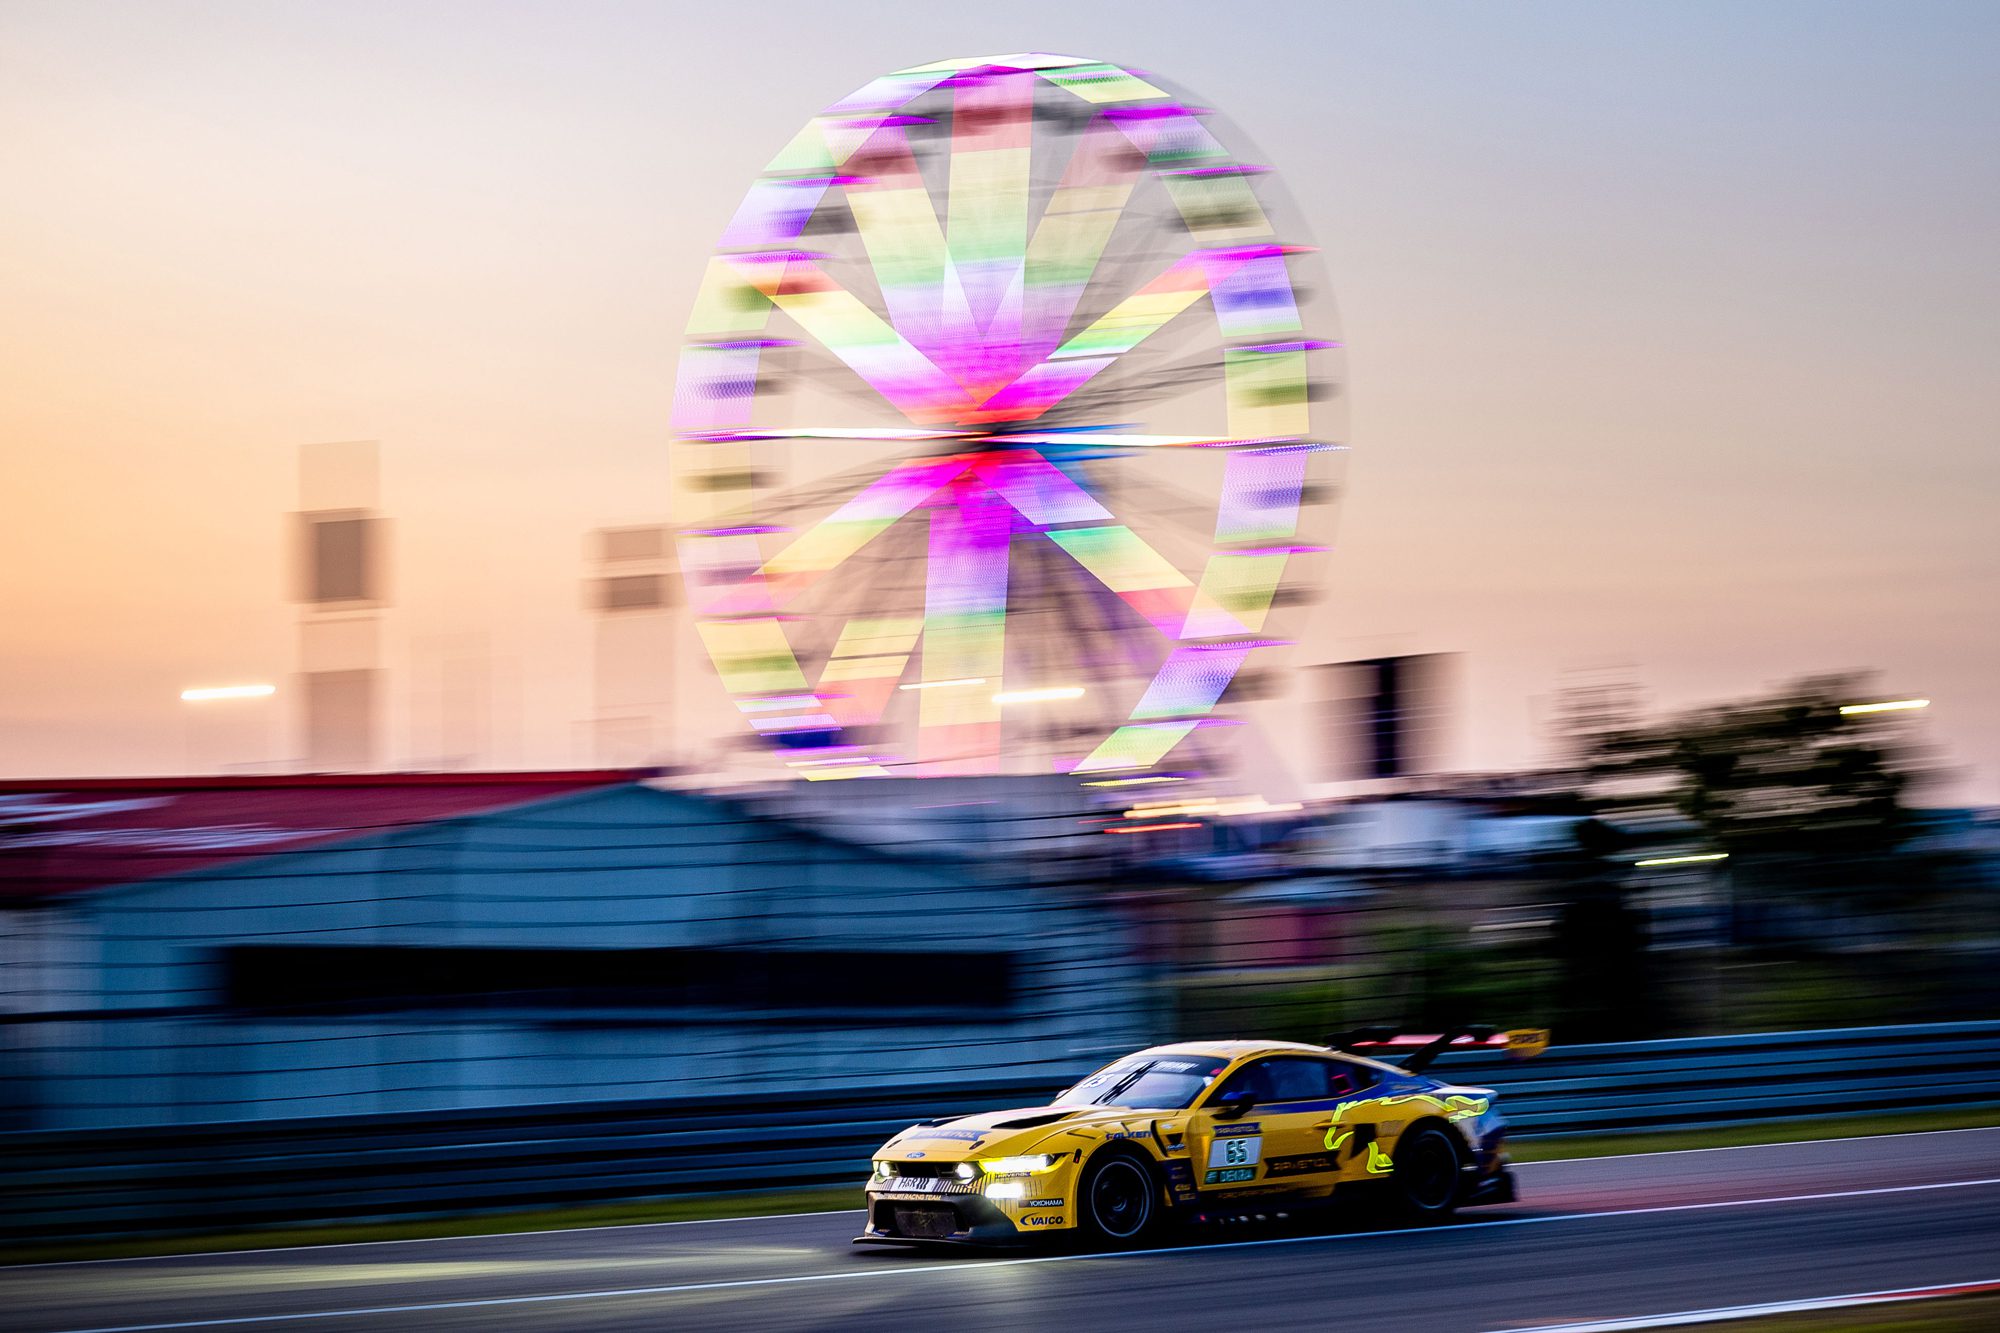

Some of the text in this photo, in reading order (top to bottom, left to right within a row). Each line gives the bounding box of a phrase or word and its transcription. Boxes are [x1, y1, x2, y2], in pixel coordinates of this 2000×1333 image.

[1106, 1131, 1152, 1140] FALKEN
[1225, 1139, 1248, 1165] 65
[898, 1177, 917, 1190] H&R
[1029, 1199, 1064, 1207] YOKOHAMA
[1031, 1216, 1064, 1226] VAICO
